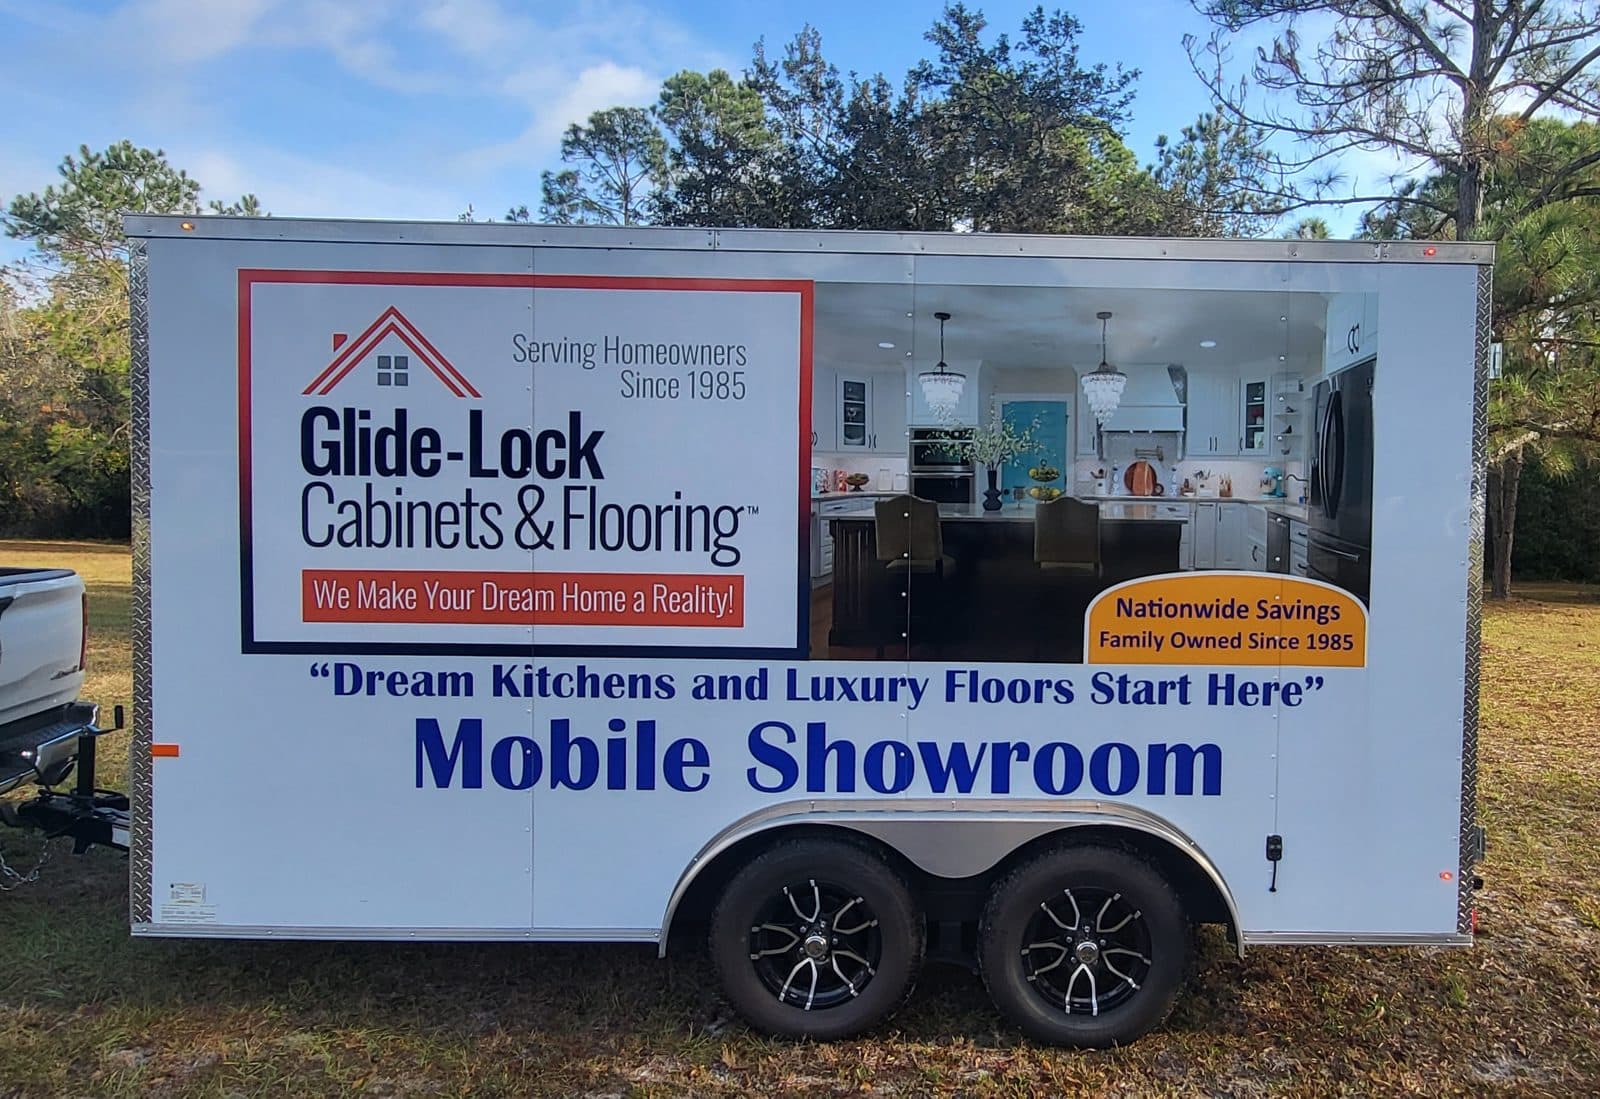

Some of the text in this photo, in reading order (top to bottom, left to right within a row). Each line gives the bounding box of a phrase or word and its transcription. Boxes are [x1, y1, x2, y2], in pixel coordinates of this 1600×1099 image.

[513, 334, 746, 368] Serving Homeowners
[620, 371, 746, 400] Since 1985
[301, 406, 605, 479] Glide-Lock
[302, 481, 502, 549] Cabinets
[515, 484, 554, 551] &
[313, 580, 733, 617] We Make Your Dream Home a Reality!
[1117, 598, 1340, 624] Nationwide Savings
[1100, 632, 1353, 652] Family Owned Since 1985
[310, 663, 1324, 711] “Dream Kitchens and Luxury Floors Start Here”
[415, 718, 1221, 796] Mobile Showroom
